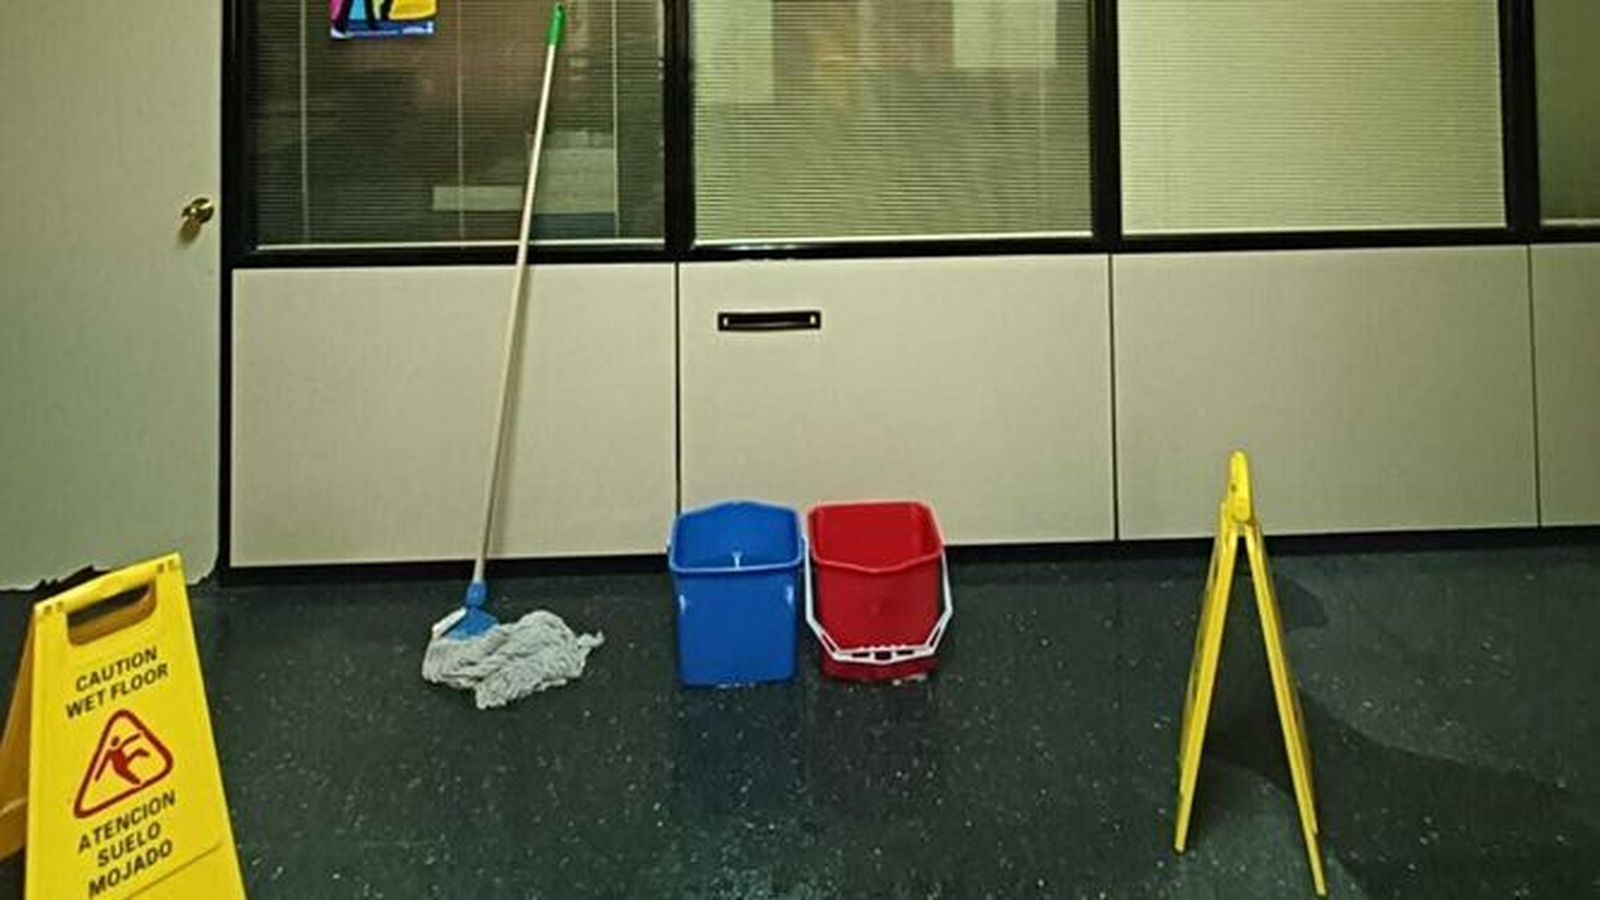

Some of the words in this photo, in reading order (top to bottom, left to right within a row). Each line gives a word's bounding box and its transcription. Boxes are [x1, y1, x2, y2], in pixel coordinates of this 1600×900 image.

[65, 689, 106, 719] WET
[110, 663, 169, 700] FLOOR
[75, 645, 157, 692] CAUTION
[77, 790, 176, 854] ATENCION
[97, 822, 162, 867] SUELO
[88, 839, 173, 898] MOJADO
